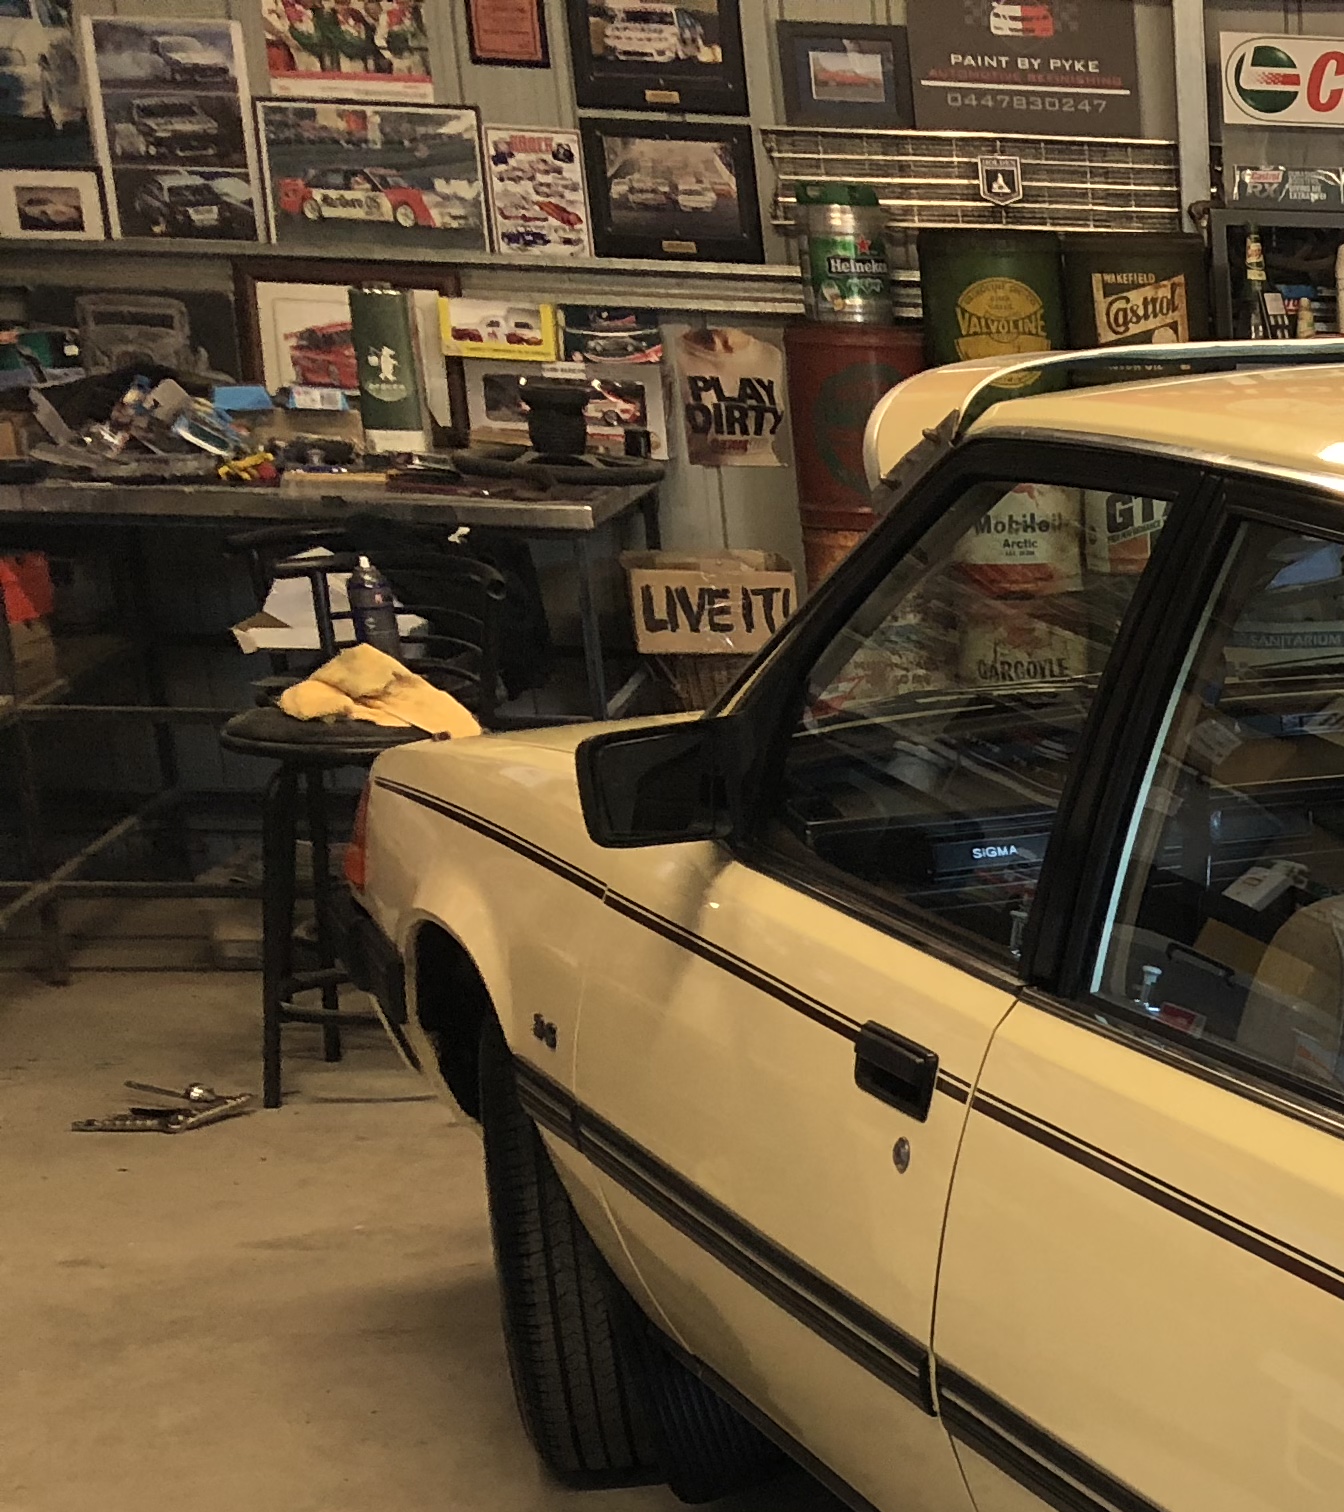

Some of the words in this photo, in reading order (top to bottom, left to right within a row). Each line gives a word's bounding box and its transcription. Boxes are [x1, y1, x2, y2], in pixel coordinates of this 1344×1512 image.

[950, 53, 1009, 69] PAINT
[1018, 57, 1041, 71] BY
[1050, 59, 1100, 73] PYKE
[947, 92, 1107, 113] 0447830247
[1246, 183, 1280, 199] RX
[1102, 273, 1156, 285] WAKEFIELD
[1105, 283, 1180, 336] Castrol
[956, 306, 1048, 337] VALVOLINE
[688, 375, 776, 402] PLAY
[687, 402, 784, 438] DIRTY
[1106, 493, 1172, 534] GT
[1002, 538, 1039, 550] Arctic
[640, 584, 734, 634] LIVE
[1251, 634, 1342, 647] SANITARIUM
[977, 657, 1069, 682] GARGOYLE
[971, 843, 1019, 859] SIGMA
